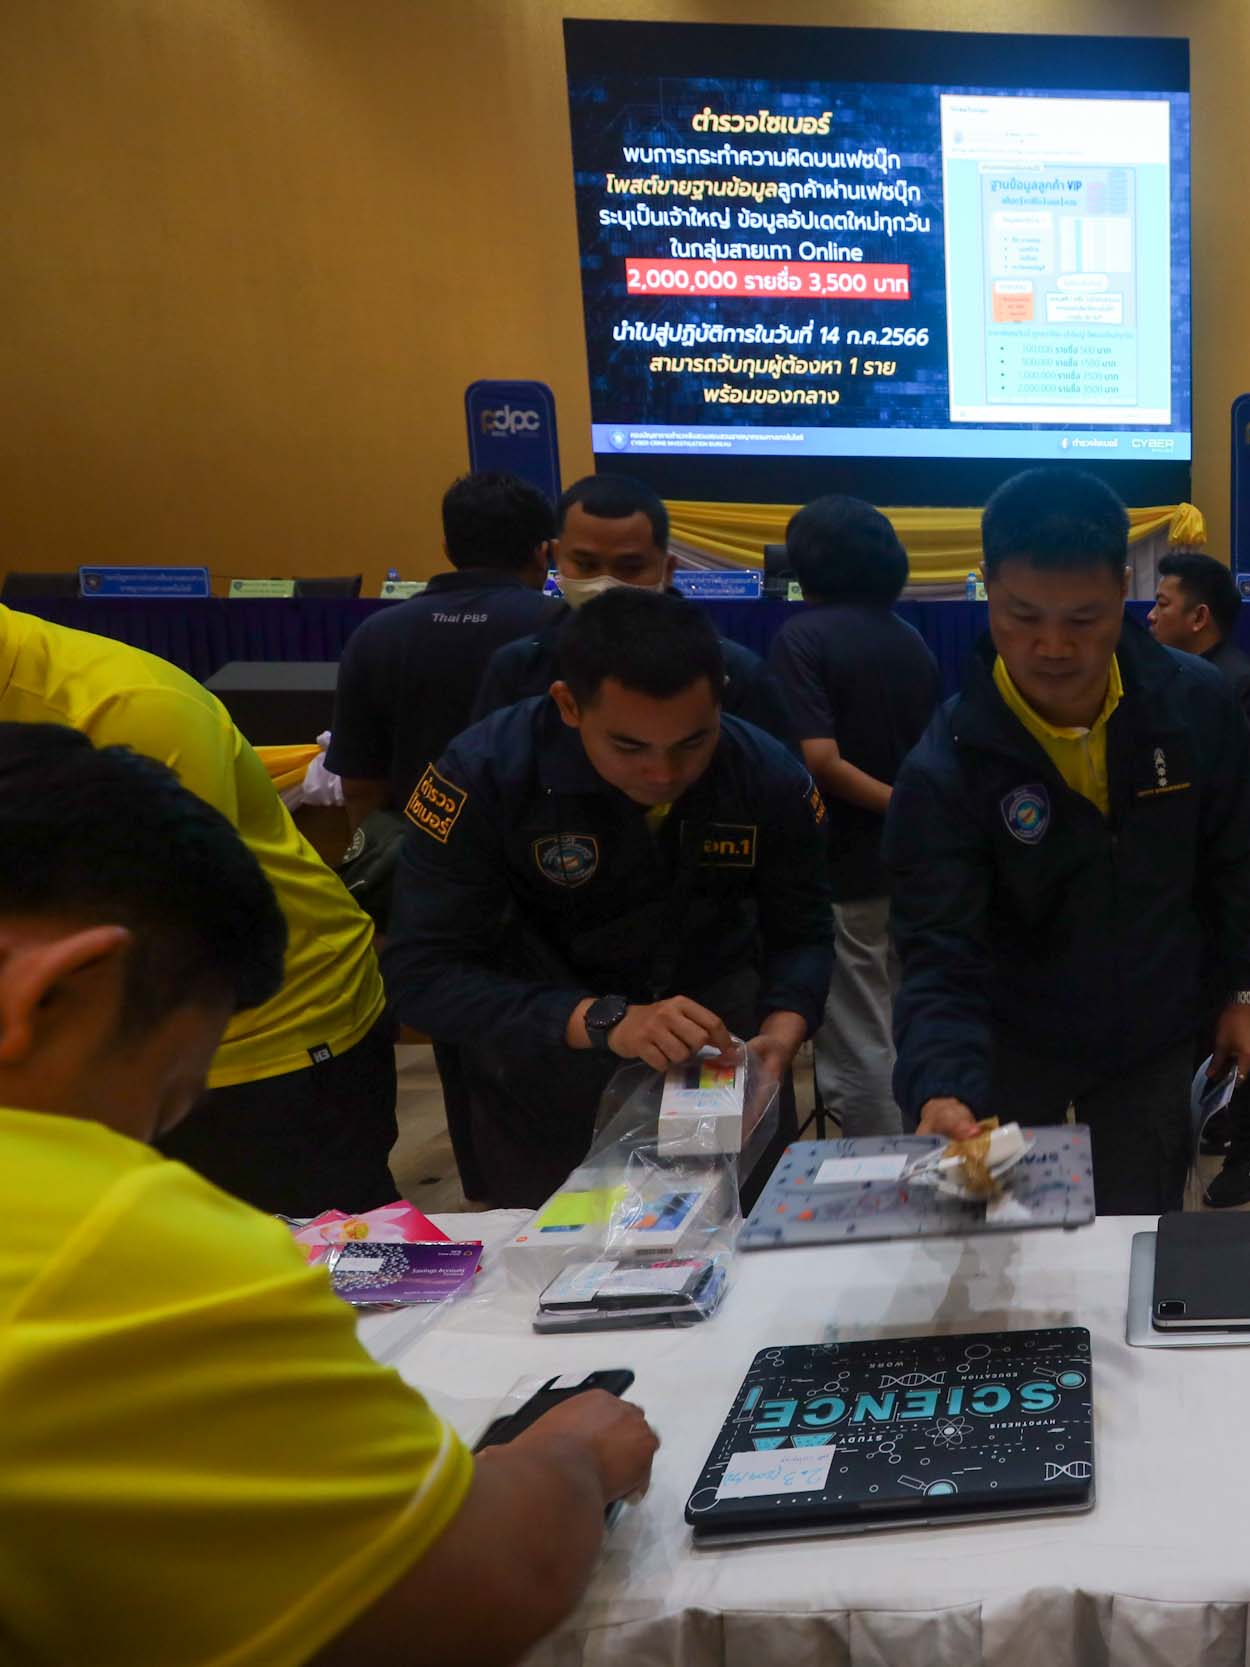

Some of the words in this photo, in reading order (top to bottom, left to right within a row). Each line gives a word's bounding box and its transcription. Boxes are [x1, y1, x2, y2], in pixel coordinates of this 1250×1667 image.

[692, 106, 833, 135] ตำรวจไซเบอร์
[623, 144, 900, 174] พบการกระทำความผิดบนเฟซบุ๊ก
[1067, 179, 1083, 191] VIP
[600, 203, 730, 231] ระบุเป็นเจ้าใหญ่
[737, 207, 931, 236] ข้อมูลอัปเดตใหม่ทุกวัน
[670, 238, 792, 263] ในกลุ่มสายเทา
[799, 242, 863, 262] Online
[628, 269, 737, 292] 2,000,000
[744, 267, 802, 291] รายชื่อ
[809, 273, 866, 295] 3,500
[874, 277, 909, 293] บาท
[612, 319, 815, 347] นำไปสู่ปฏิบัติการในวันที่
[819, 327, 839, 344] 14
[650, 353, 841, 379] สามารถจับกุมผู้ต้องหา
[849, 358, 857, 375] 1
[863, 359, 896, 376] ราย
[703, 384, 840, 405] พร้อมของกลาง
[480, 404, 541, 435] pdpc
[1131, 439, 1174, 449] CYBER
[432, 612, 460, 623] Thai
[462, 613, 488, 624] PBS
[869, 1361, 904, 1369] WORK
[960, 1372, 1019, 1381] EDUCATION
[755, 1382, 1058, 1431] SCIENCE
[989, 1418, 1057, 1430] HYPOTHESIS
[839, 1434, 883, 1445] STUDY
